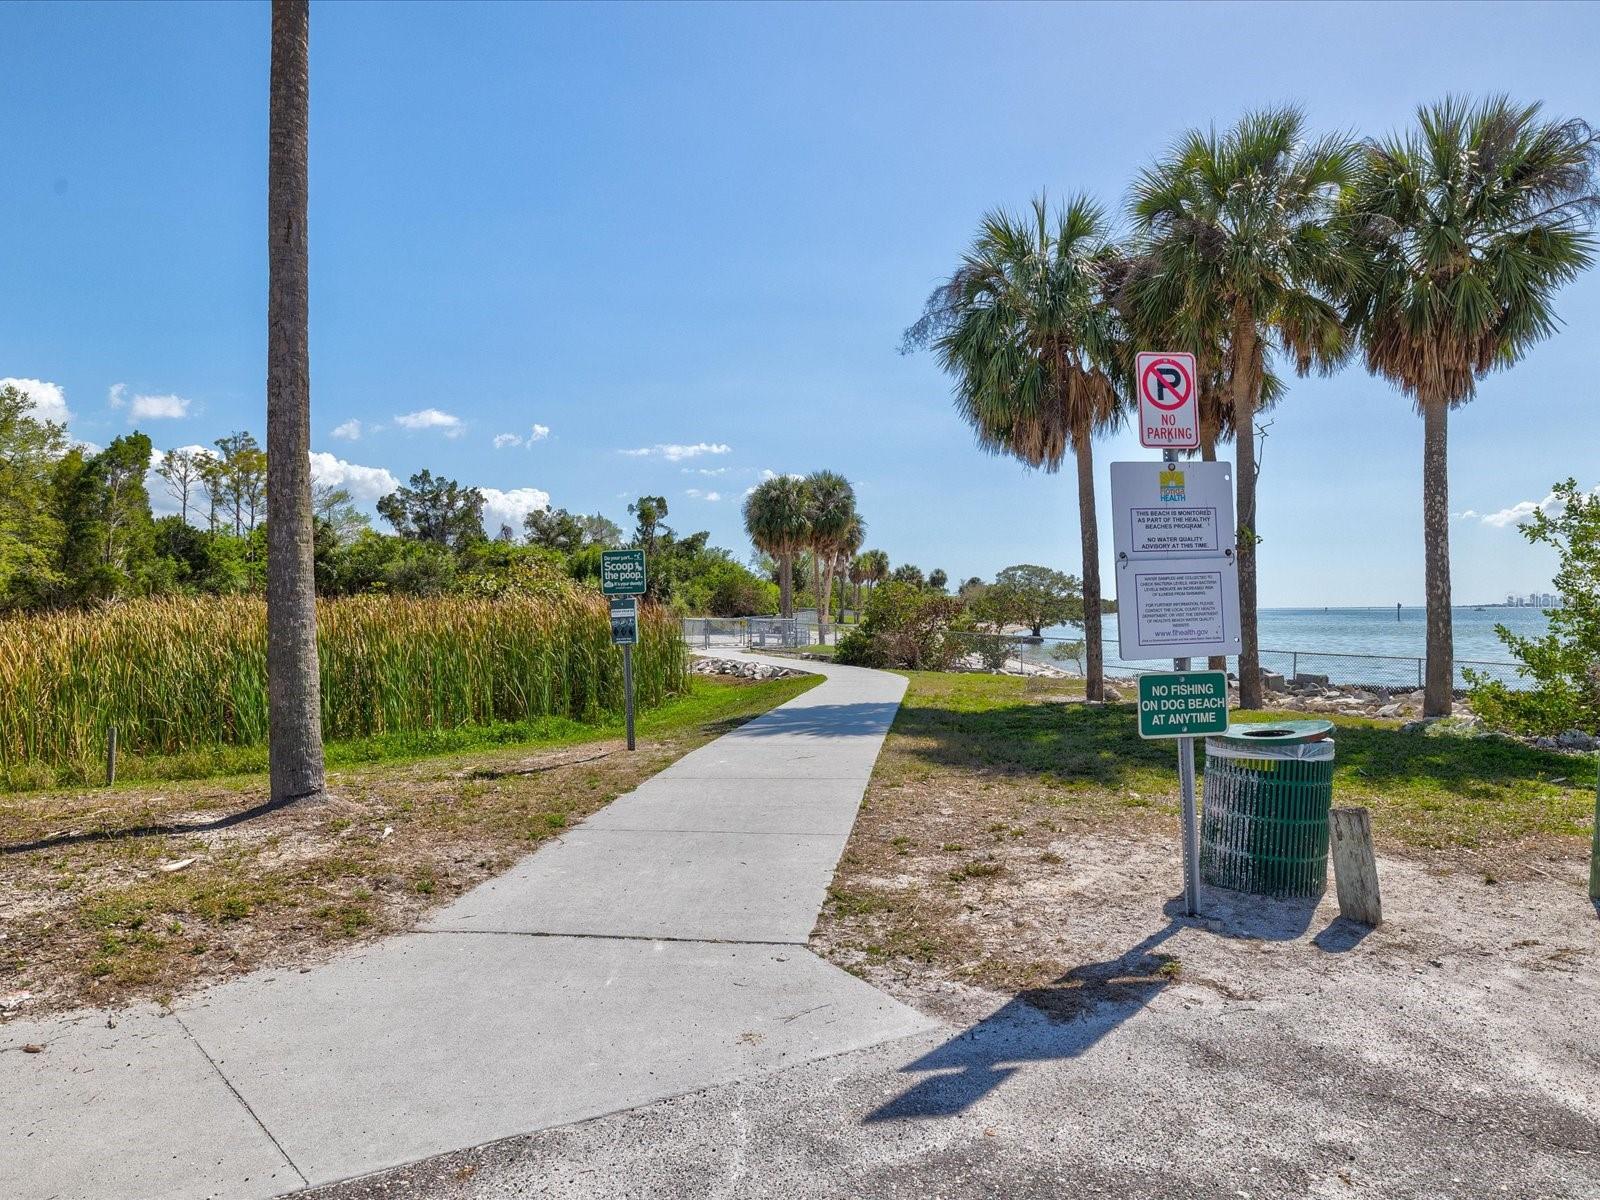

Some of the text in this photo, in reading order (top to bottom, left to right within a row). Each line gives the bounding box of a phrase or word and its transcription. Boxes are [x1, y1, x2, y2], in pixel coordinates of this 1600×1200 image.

[1161, 414, 1176, 426] NO
[1147, 428, 1192, 440] PARKING
[604, 562, 634, 572] Scoop
[605, 572, 643, 581] the poop.
[1152, 684, 1214, 696] NO FISHING
[1142, 698, 1225, 711] ON DOG BEACH
[1152, 712, 1216, 725] AT ANYTIME
